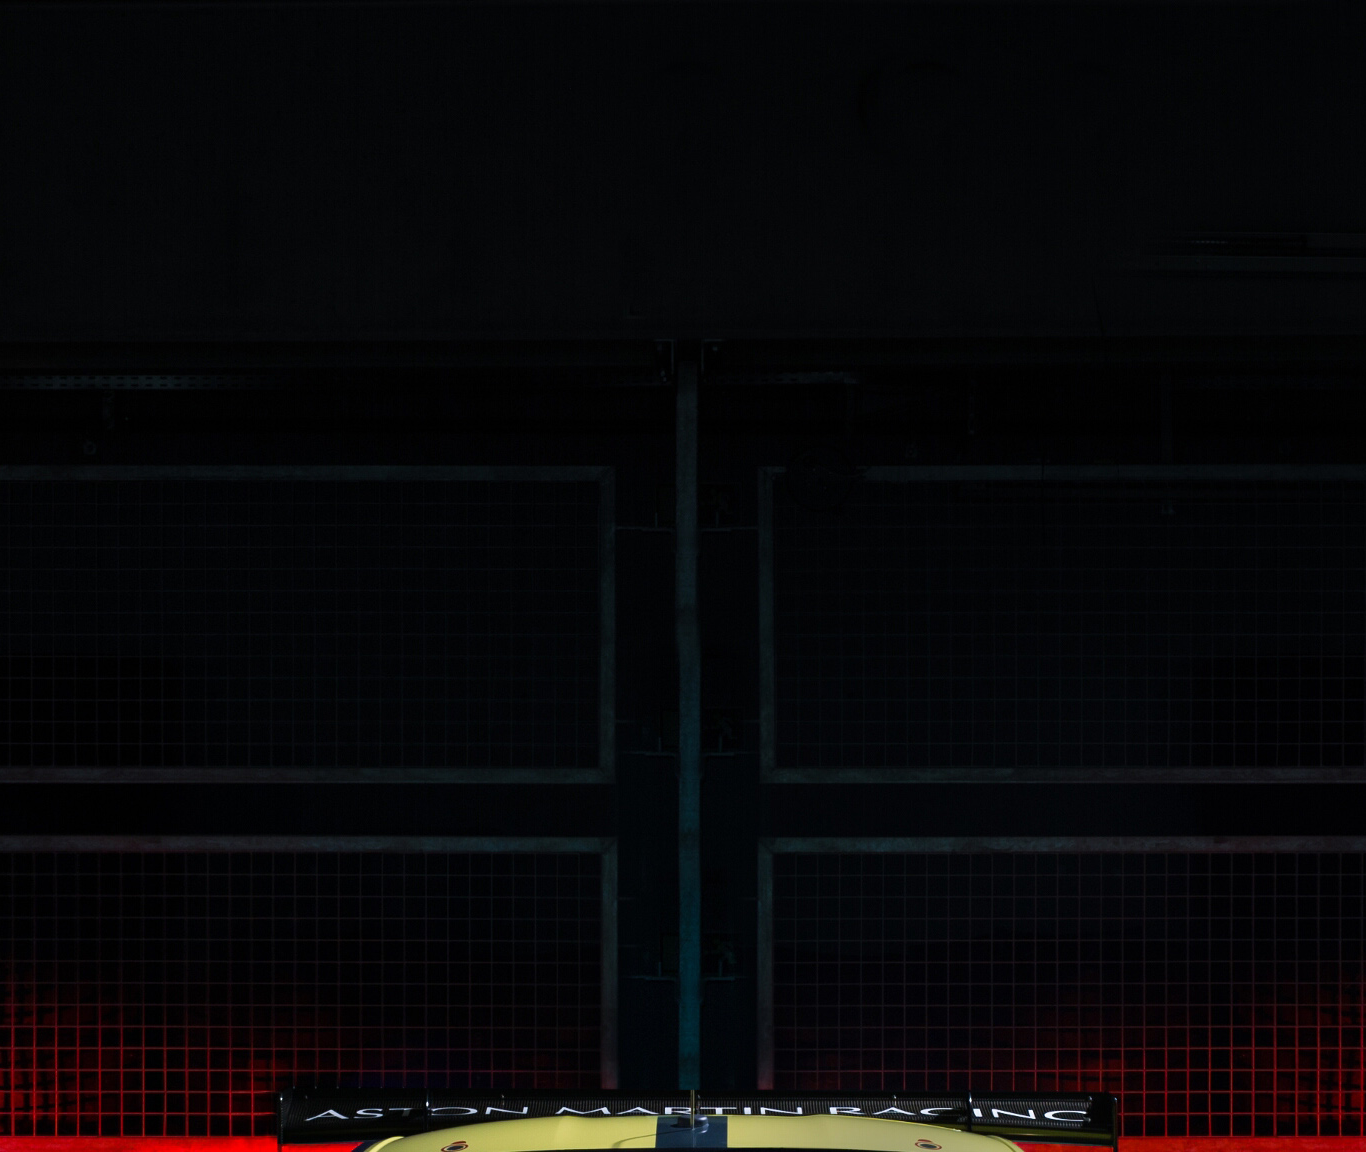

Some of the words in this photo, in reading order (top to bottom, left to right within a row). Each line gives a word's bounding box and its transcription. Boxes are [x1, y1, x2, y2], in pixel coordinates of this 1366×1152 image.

[304, 1106, 529, 1122] ASTON
[554, 1106, 803, 1115] MARTIN
[827, 1106, 1092, 1123] RACING
